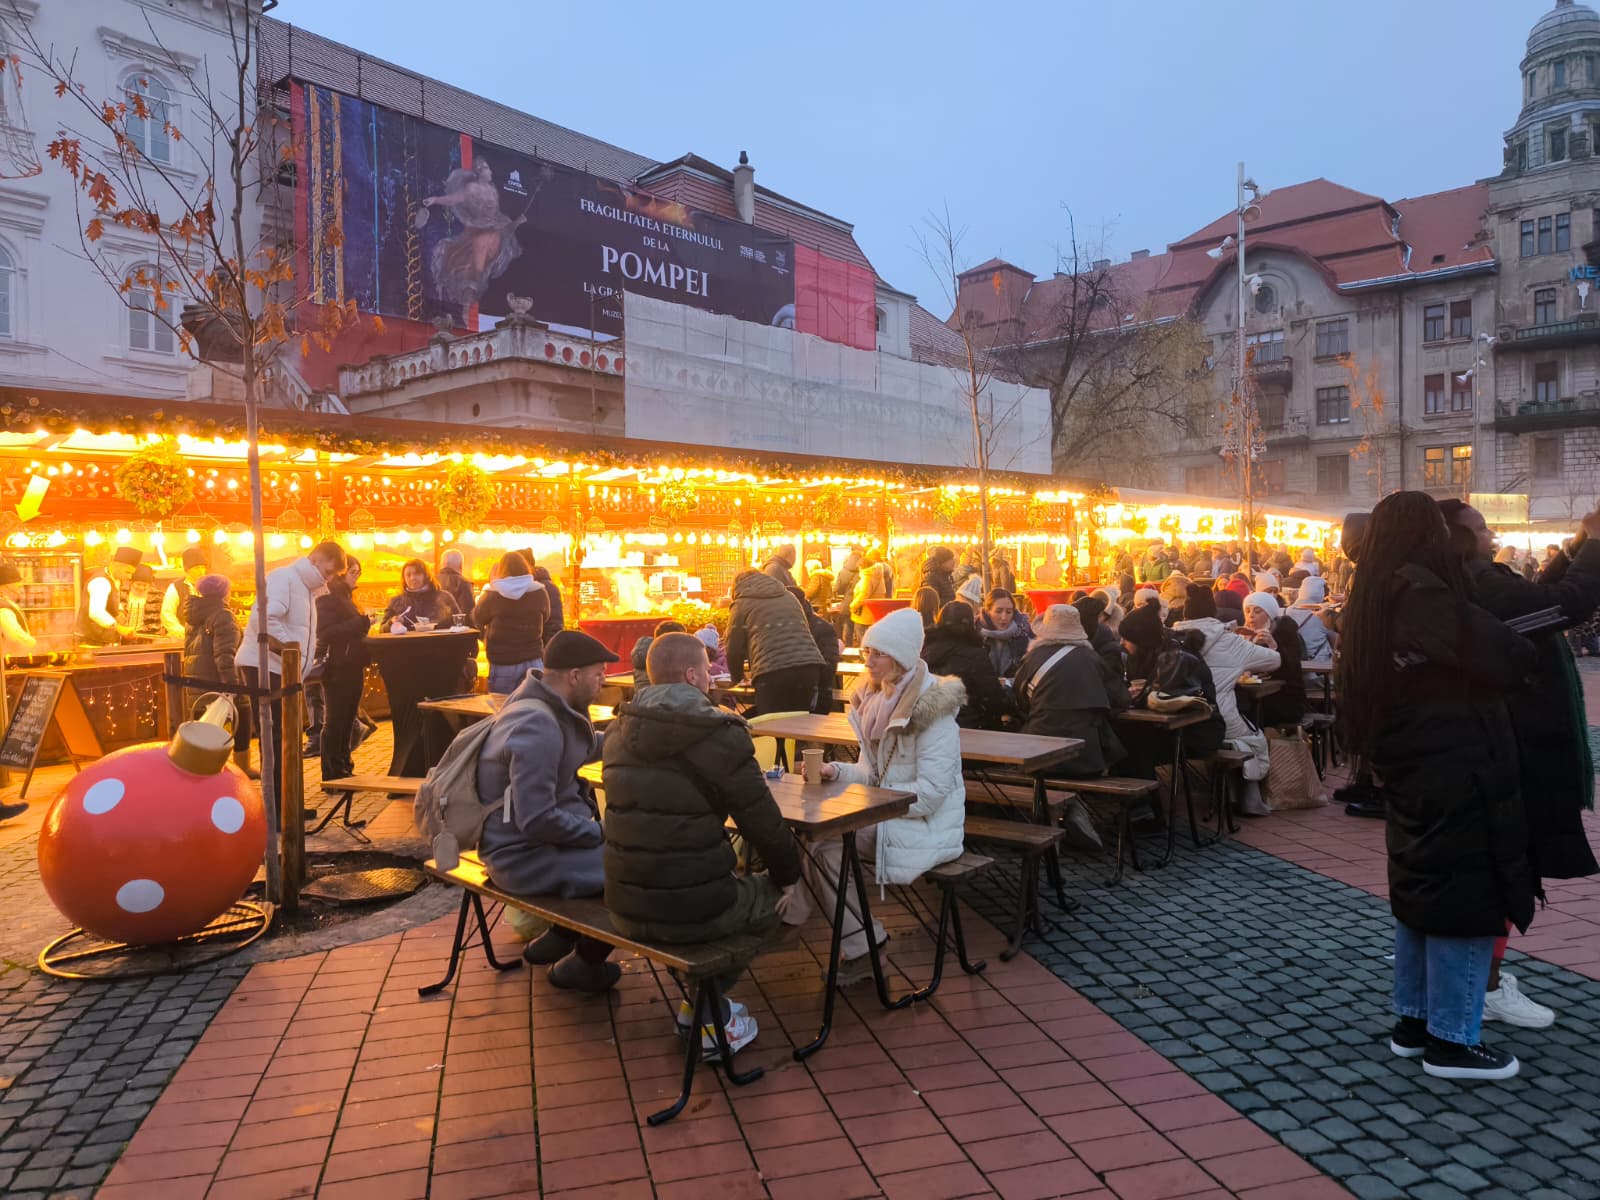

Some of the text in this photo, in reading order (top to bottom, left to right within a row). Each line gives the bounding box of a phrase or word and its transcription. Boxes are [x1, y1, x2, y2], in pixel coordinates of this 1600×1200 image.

[580, 198, 660, 232] FRAGILITATEA
[643, 236, 670, 252] DE LA
[600, 245, 709, 297] POMPEI
[583, 281, 597, 295] LA
